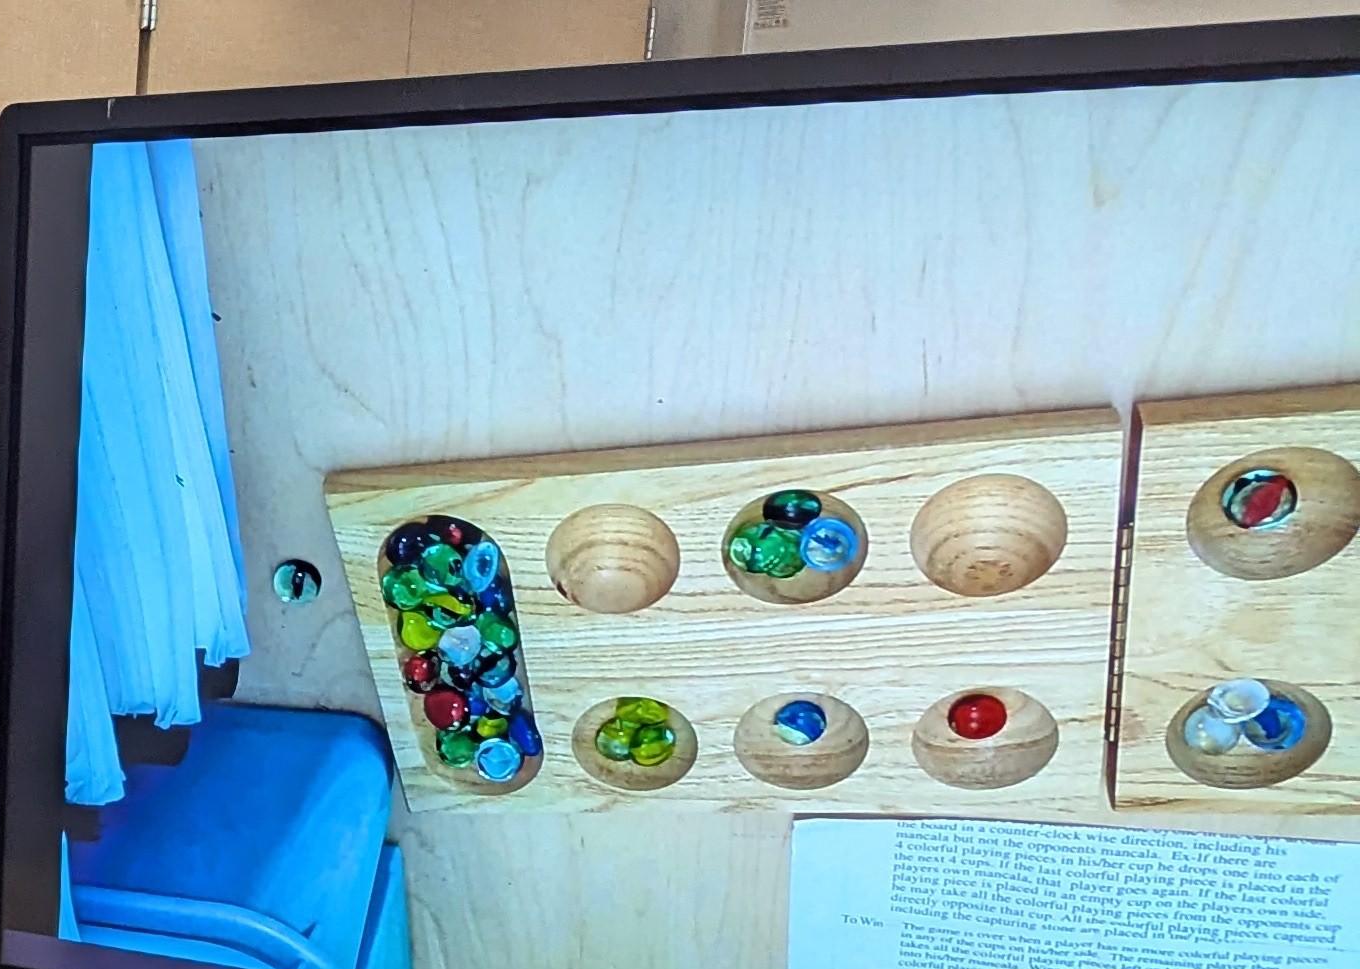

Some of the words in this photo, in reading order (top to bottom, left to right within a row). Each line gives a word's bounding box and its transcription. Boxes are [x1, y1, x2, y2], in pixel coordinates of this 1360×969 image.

[896, 830, 948, 841] mancala
[953, 834, 973, 843] but
[978, 837, 998, 845] not
[1003, 838, 1023, 848] the
[1027, 841, 1095, 857] opponents
[1213, 855, 1248, 866] there
[1254, 859, 1276, 868] are
[988, 824, 1080, 840] counter-clock
[1086, 831, 1116, 843] wise
[1193, 839, 1260, 856] including
[1265, 845, 1287, 855] his
[894, 851, 913, 861] the
[918, 853, 944, 863] next
[948, 855, 955, 863] 4
[999, 860, 1009, 868] If
[1014, 862, 1034, 871] the
[1039, 864, 1060, 875] last
[1066, 867, 1119, 881] colorful
[1124, 871, 1174, 887] playing
[1180, 877, 1216, 890] piece
[1238, 881, 1285, 896] placed
[1309, 885, 1330, 895] the
[895, 840, 902, 848] 4
[907, 841, 957, 853] colorful
[962, 846, 1010, 860] playing
[1015, 852, 1055, 863] pieces
[1061, 857, 1073, 865] in
[1128, 862, 1152, 873] cup
[1157, 861, 1173, 872] he
[1178, 864, 1217, 877] drops
[1222, 869, 1248, 878] one
[1254, 871, 1281, 881] into
[1285, 870, 1319, 883] each
[1323, 872, 1342, 883] of
[841, 914, 857, 924] To
[860, 916, 883, 927] Win
